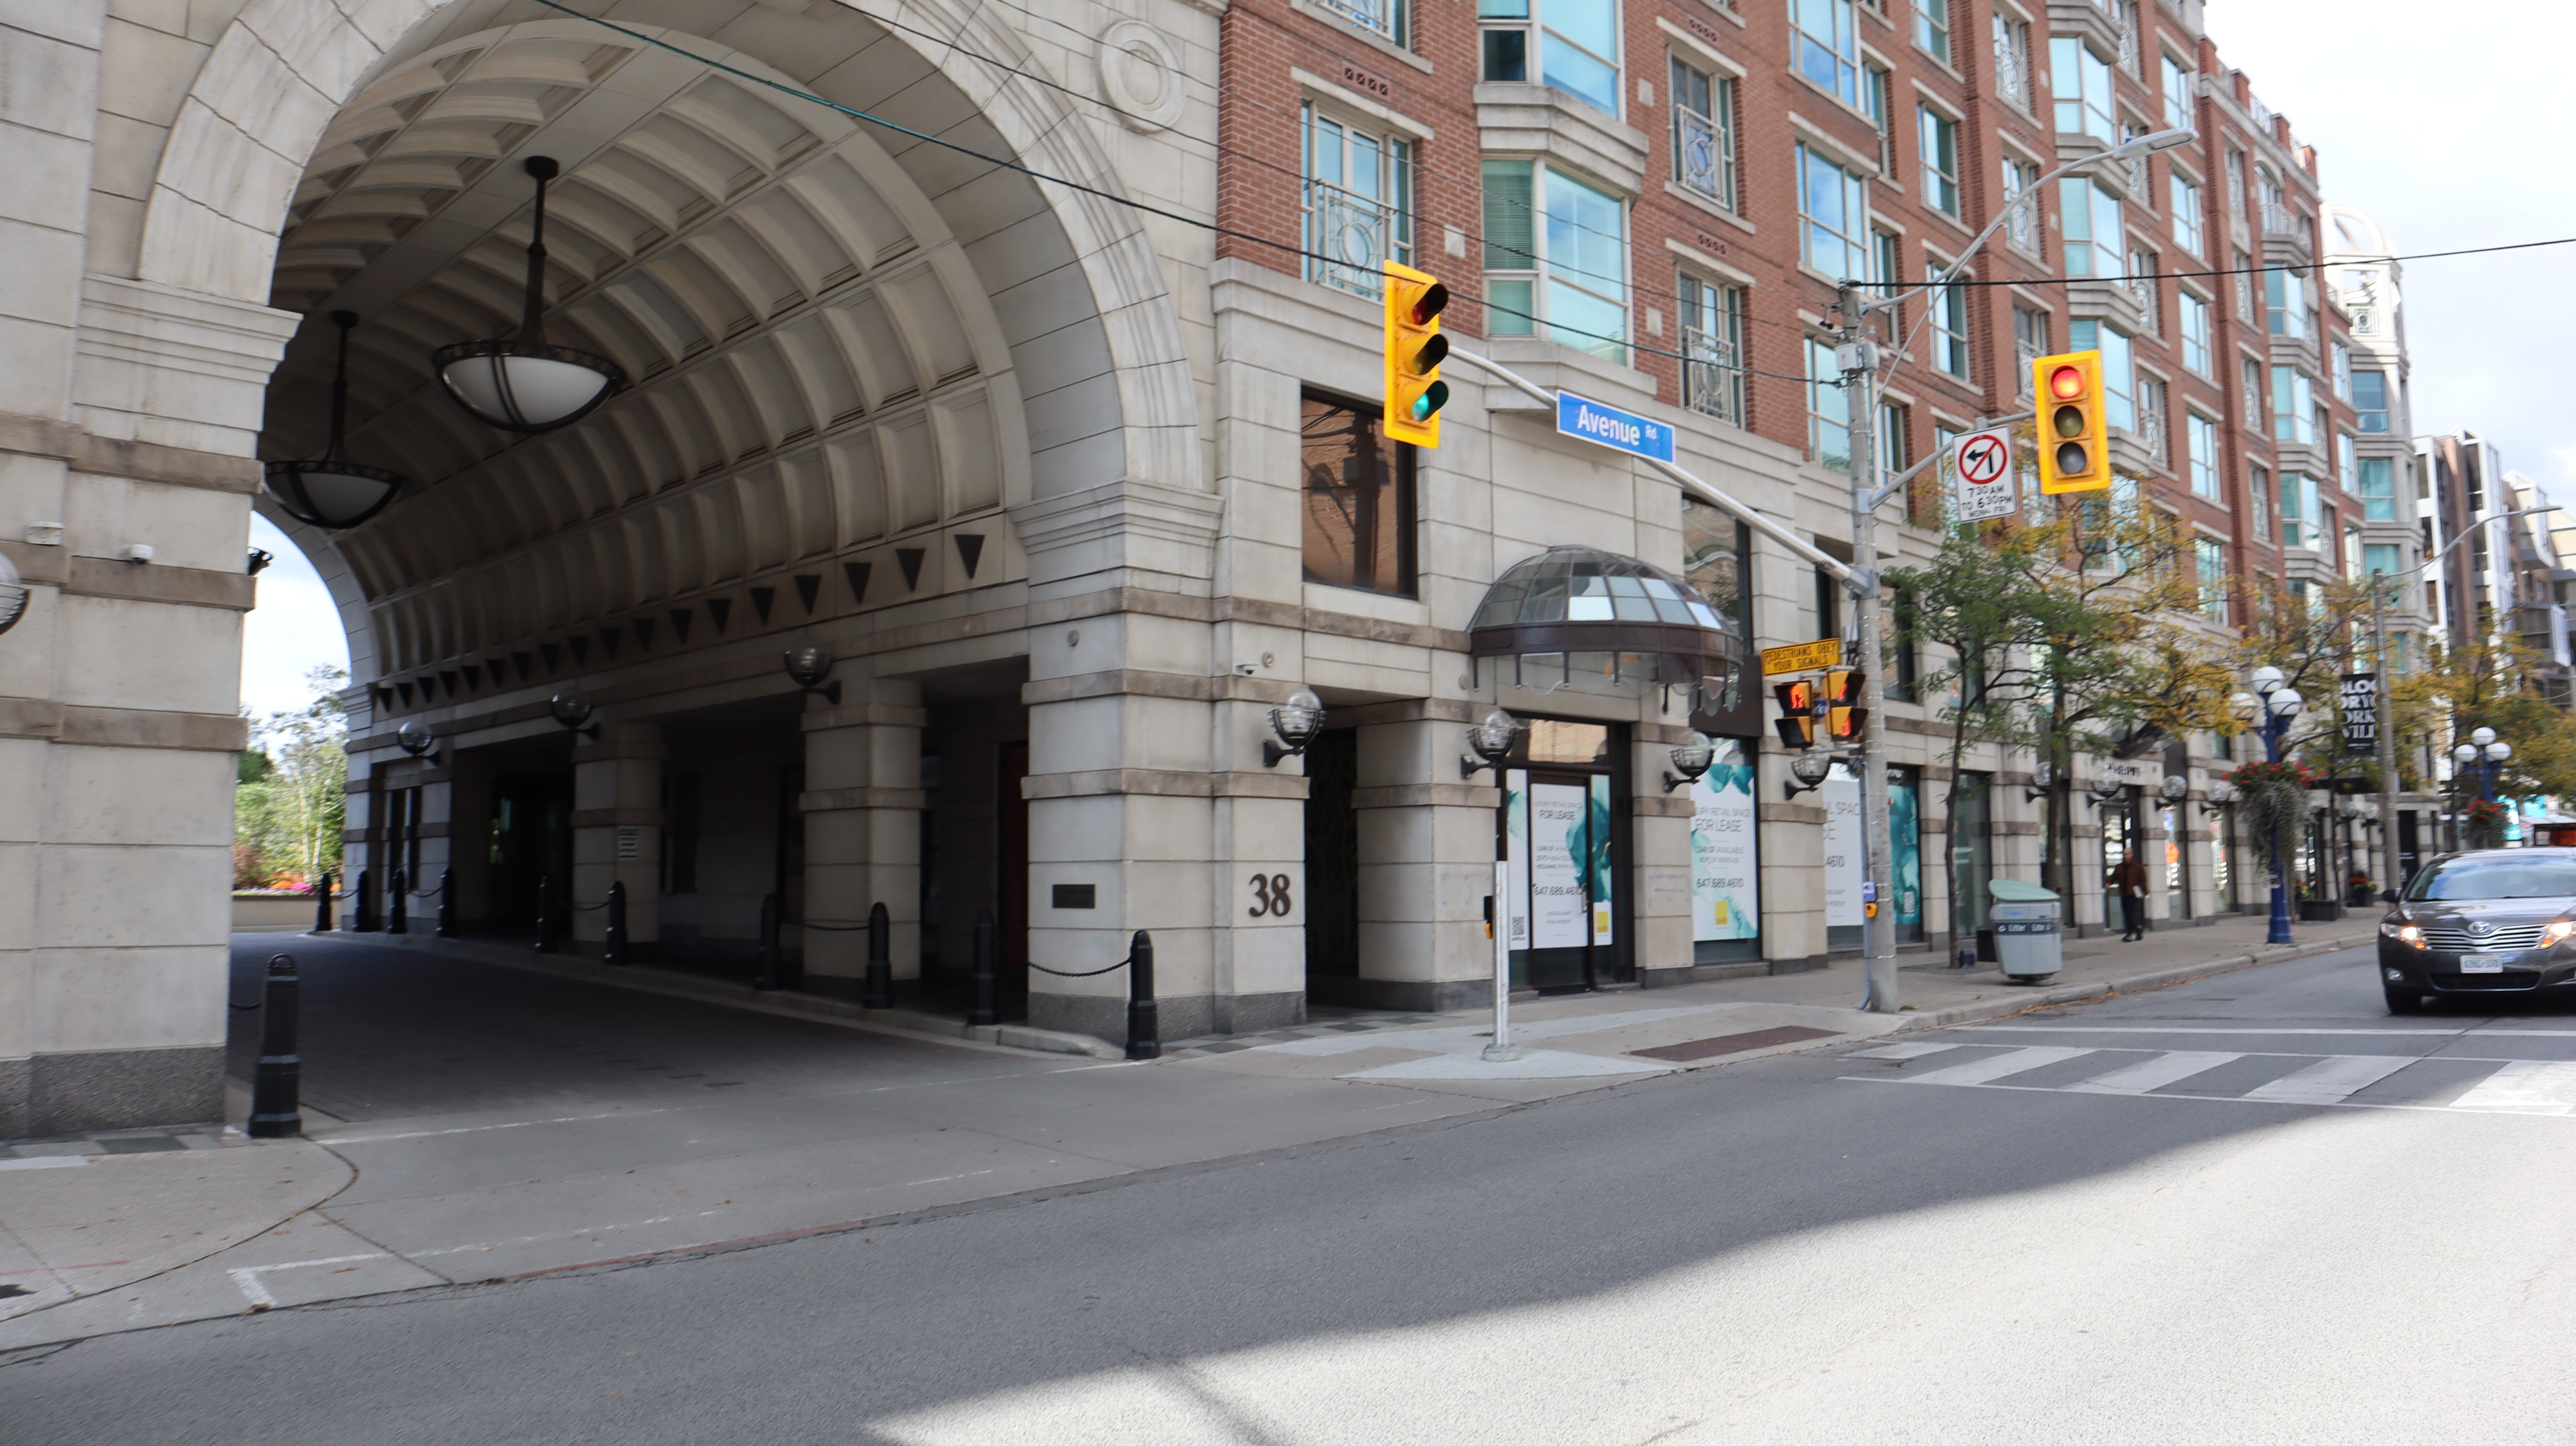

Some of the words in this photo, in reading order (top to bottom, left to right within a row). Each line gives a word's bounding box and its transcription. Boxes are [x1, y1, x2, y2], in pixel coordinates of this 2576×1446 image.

[1577, 404, 1641, 446] Avenue
[1645, 424, 1657, 440] Rd
[1961, 501, 1973, 511] TO
[1764, 645, 1812, 662] PEDESTRIANS
[1818, 641, 1837, 653] OBEY
[1774, 659, 1792, 671] YOUR
[1797, 654, 1828, 668] SIGNALS
[1539, 809, 1553, 820] FOR
[1554, 810, 1576, 820] LEASE
[1732, 808, 1752, 818] SPACE
[1835, 802, 1860, 816] SPAC
[1695, 818, 1714, 832] FOR
[1715, 819, 1743, 832] LEASE
[1249, 873, 1291, 917] 38
